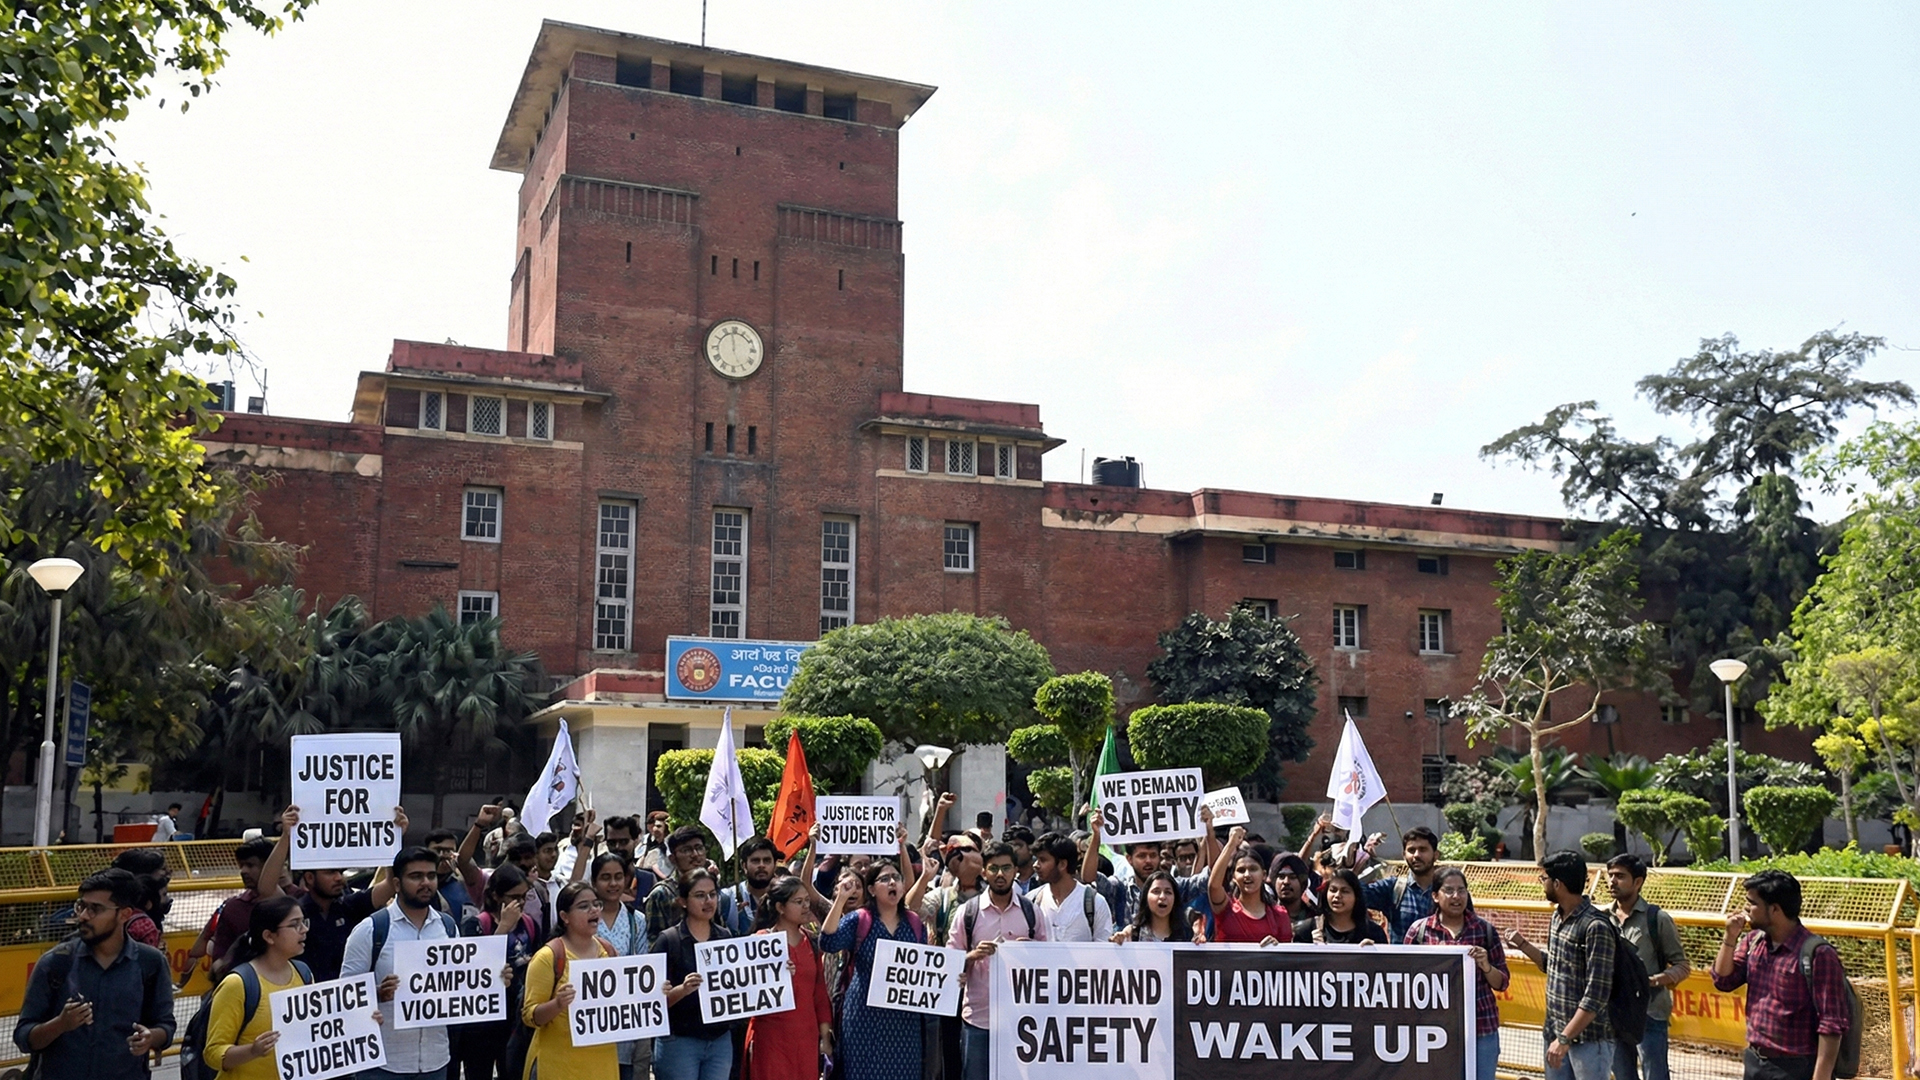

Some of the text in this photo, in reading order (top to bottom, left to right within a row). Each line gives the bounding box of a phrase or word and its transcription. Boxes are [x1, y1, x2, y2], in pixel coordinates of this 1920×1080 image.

[299, 754, 394, 782] JUSTICE
[1102, 774, 1198, 798] WE DEMAND
[326, 788, 370, 815] FOR
[822, 805, 895, 822] JUSTICE FOR
[1098, 796, 1200, 837] SAFETY
[297, 821, 395, 849] STUDENTS
[821, 825, 896, 845] STUDENTS
[426, 945, 477, 967] STOP
[713, 944, 739, 965] TO
[744, 938, 783, 961] UGC
[895, 947, 945, 969] NO TO
[410, 968, 492, 994] CAMPUS
[582, 965, 655, 1001] NO TO
[707, 962, 783, 992] EQUITY
[886, 966, 948, 989] EQUITY
[1012, 968, 1162, 1006] WE DEMAND
[1187, 970, 1450, 1010] DU ADMINISTRATION
[282, 982, 369, 1024] JUSTICE
[401, 993, 500, 1022] VIOLENCE
[710, 986, 785, 1018] DELAY
[887, 987, 940, 1010] DELAY
[310, 1018, 345, 1043] FOR
[575, 1000, 664, 1037] STUDENTS
[1016, 1015, 1157, 1064] SAFETY
[1189, 1021, 1449, 1064] WAKE UP
[281, 1033, 381, 1080] STUDENTS
